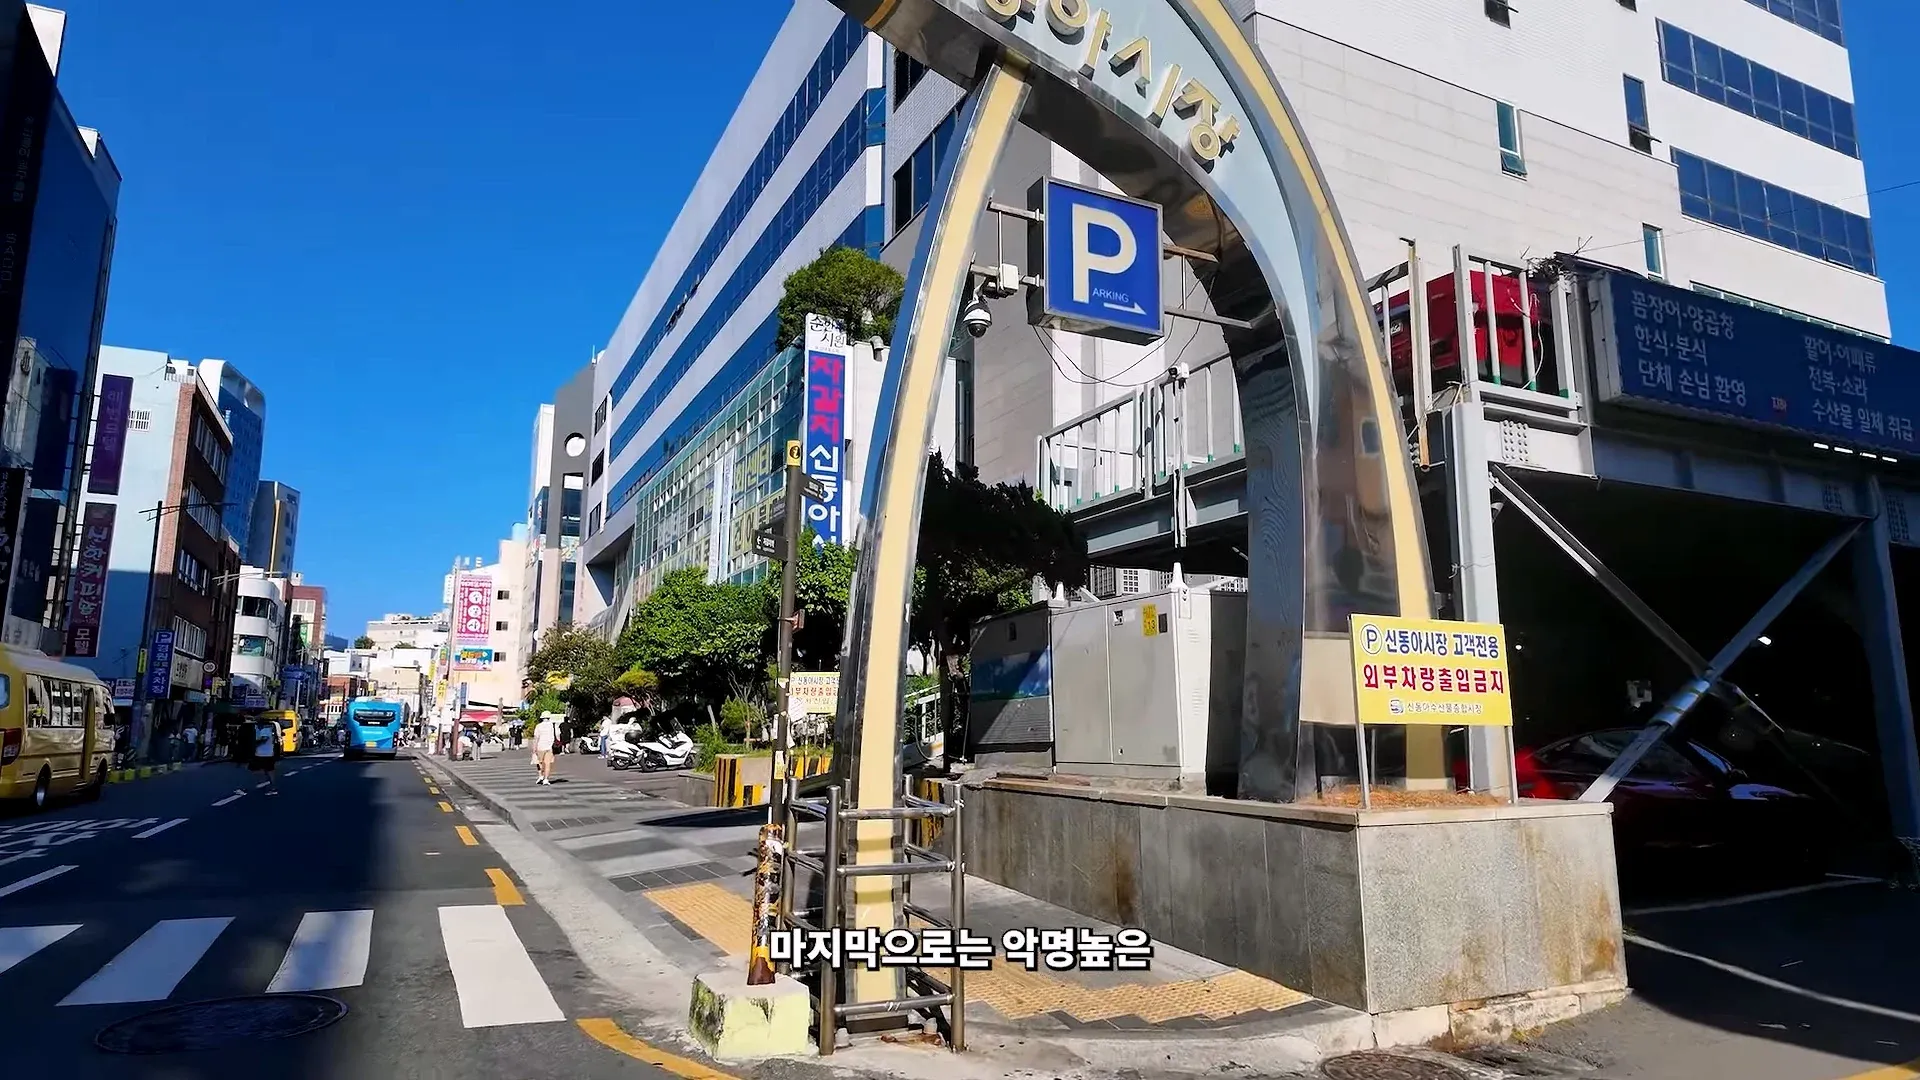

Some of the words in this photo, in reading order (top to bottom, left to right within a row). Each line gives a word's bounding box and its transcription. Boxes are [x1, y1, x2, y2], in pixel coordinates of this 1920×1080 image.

[1072, 202, 1137, 304] P
[1638, 358, 1674, 392] 단체
[1678, 368, 1711, 400] 손님
[1714, 375, 1746, 407] 환영
[1812, 398, 1853, 430] 수산물
[1857, 408, 1885, 436] 일체
[1887, 416, 1915, 442] 취급
[74, 628, 91, 655] 모텔
[1385, 629, 1448, 656] 신동아시장
[1452, 633, 1499, 659] 고객전용
[1363, 664, 1504, 694] 외부차량출입금지
